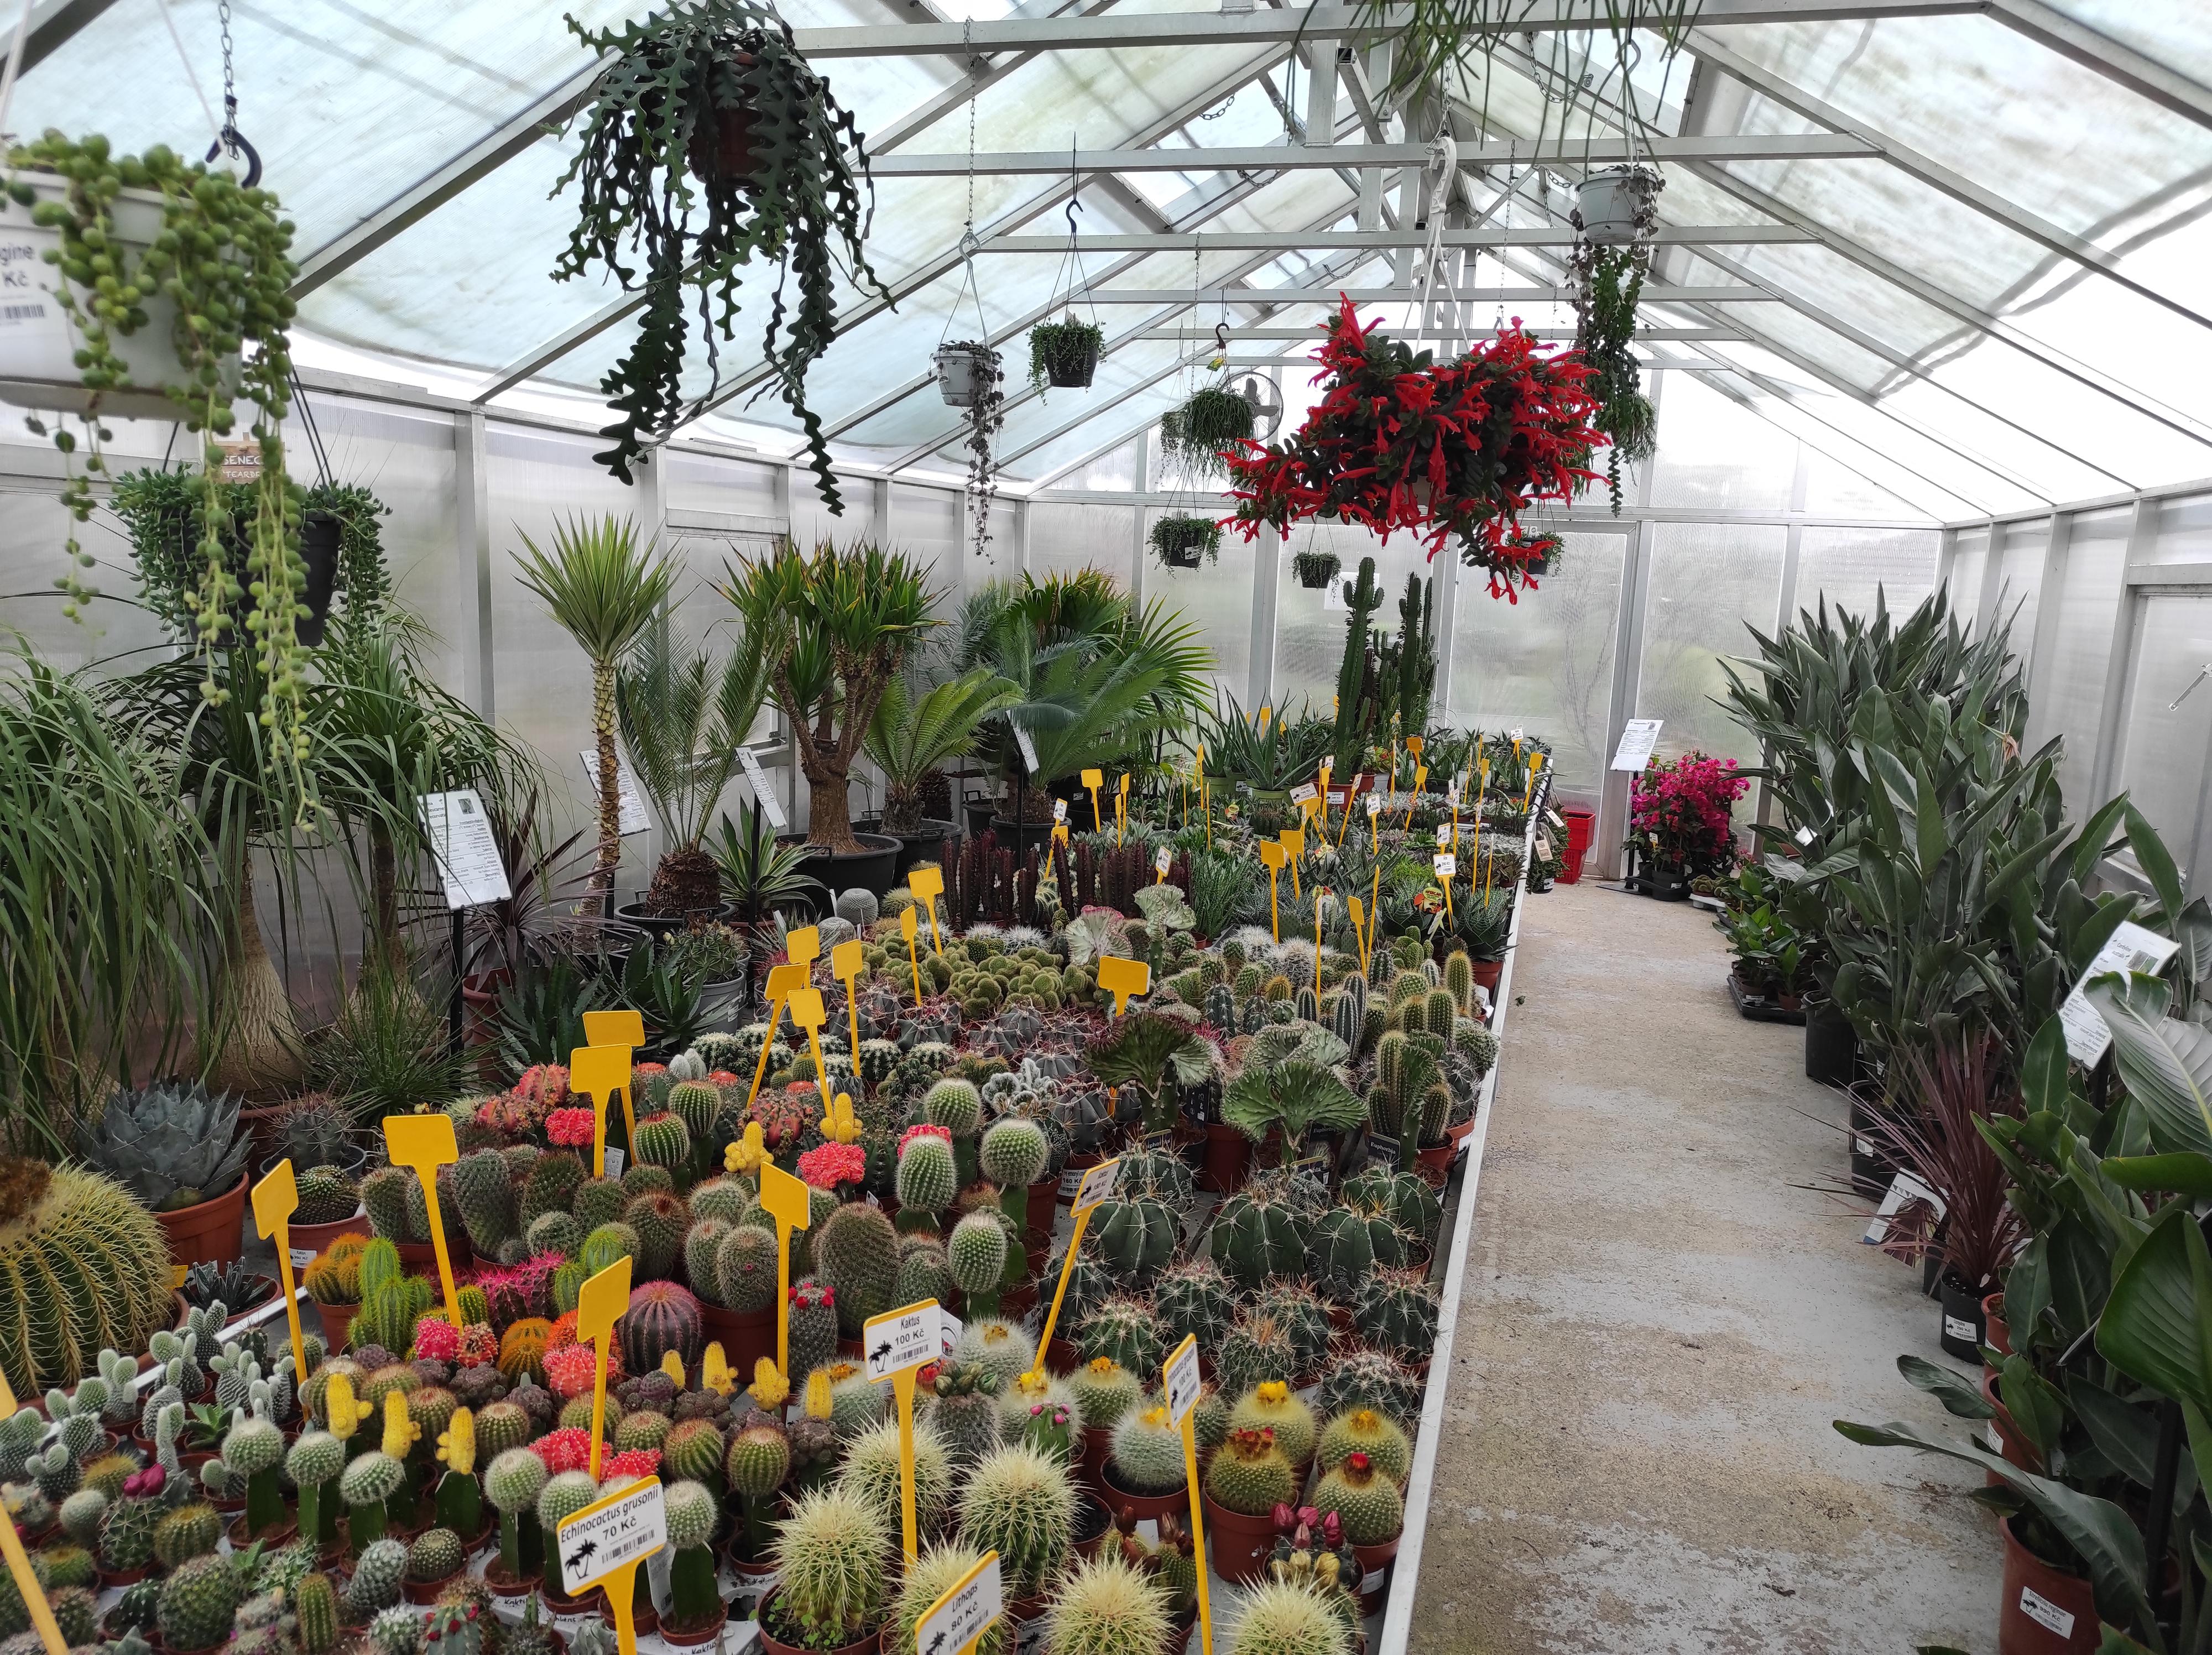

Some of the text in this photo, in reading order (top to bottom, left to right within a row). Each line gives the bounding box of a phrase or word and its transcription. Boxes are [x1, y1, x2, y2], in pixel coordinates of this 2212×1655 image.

[224, 455, 262, 465] SENEC
[1370, 1141, 1396, 1155] Euphorbia
[900, 1315, 920, 1330] Kaktus
[895, 1333, 910, 1346] 100
[912, 1328, 925, 1340] Kč
[561, 1506, 620, 1543] Echinocactus
[623, 1485, 659, 1516] grusonii
[603, 1526, 617, 1541] 70
[621, 1516, 637, 1532] Kč
[952, 1582, 978, 1613] Lithops
[951, 1600, 978, 1631] 80 Kč
